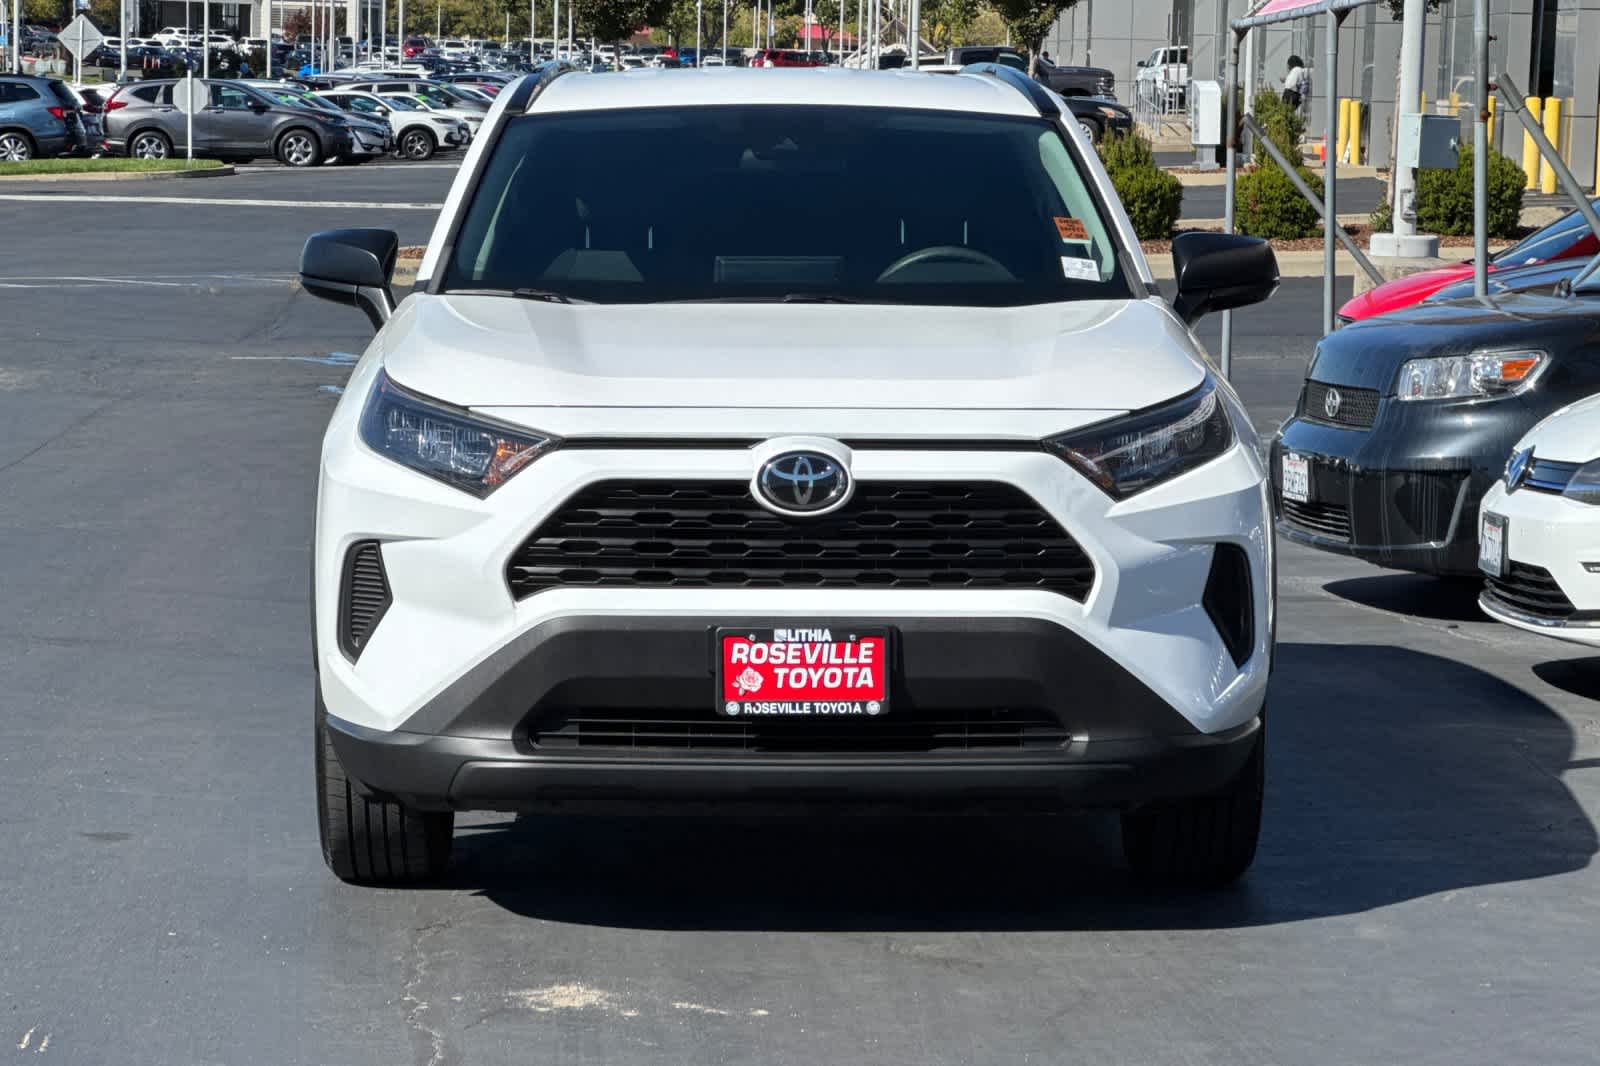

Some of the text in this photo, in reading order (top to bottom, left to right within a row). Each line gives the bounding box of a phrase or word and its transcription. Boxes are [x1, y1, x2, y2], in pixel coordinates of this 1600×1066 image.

[786, 629, 832, 642] LITHIA
[731, 642, 875, 665] ROSEVILLE
[774, 667, 874, 689] TOYOTA
[744, 702, 862, 714] ROSEVILLE TOYOTA
